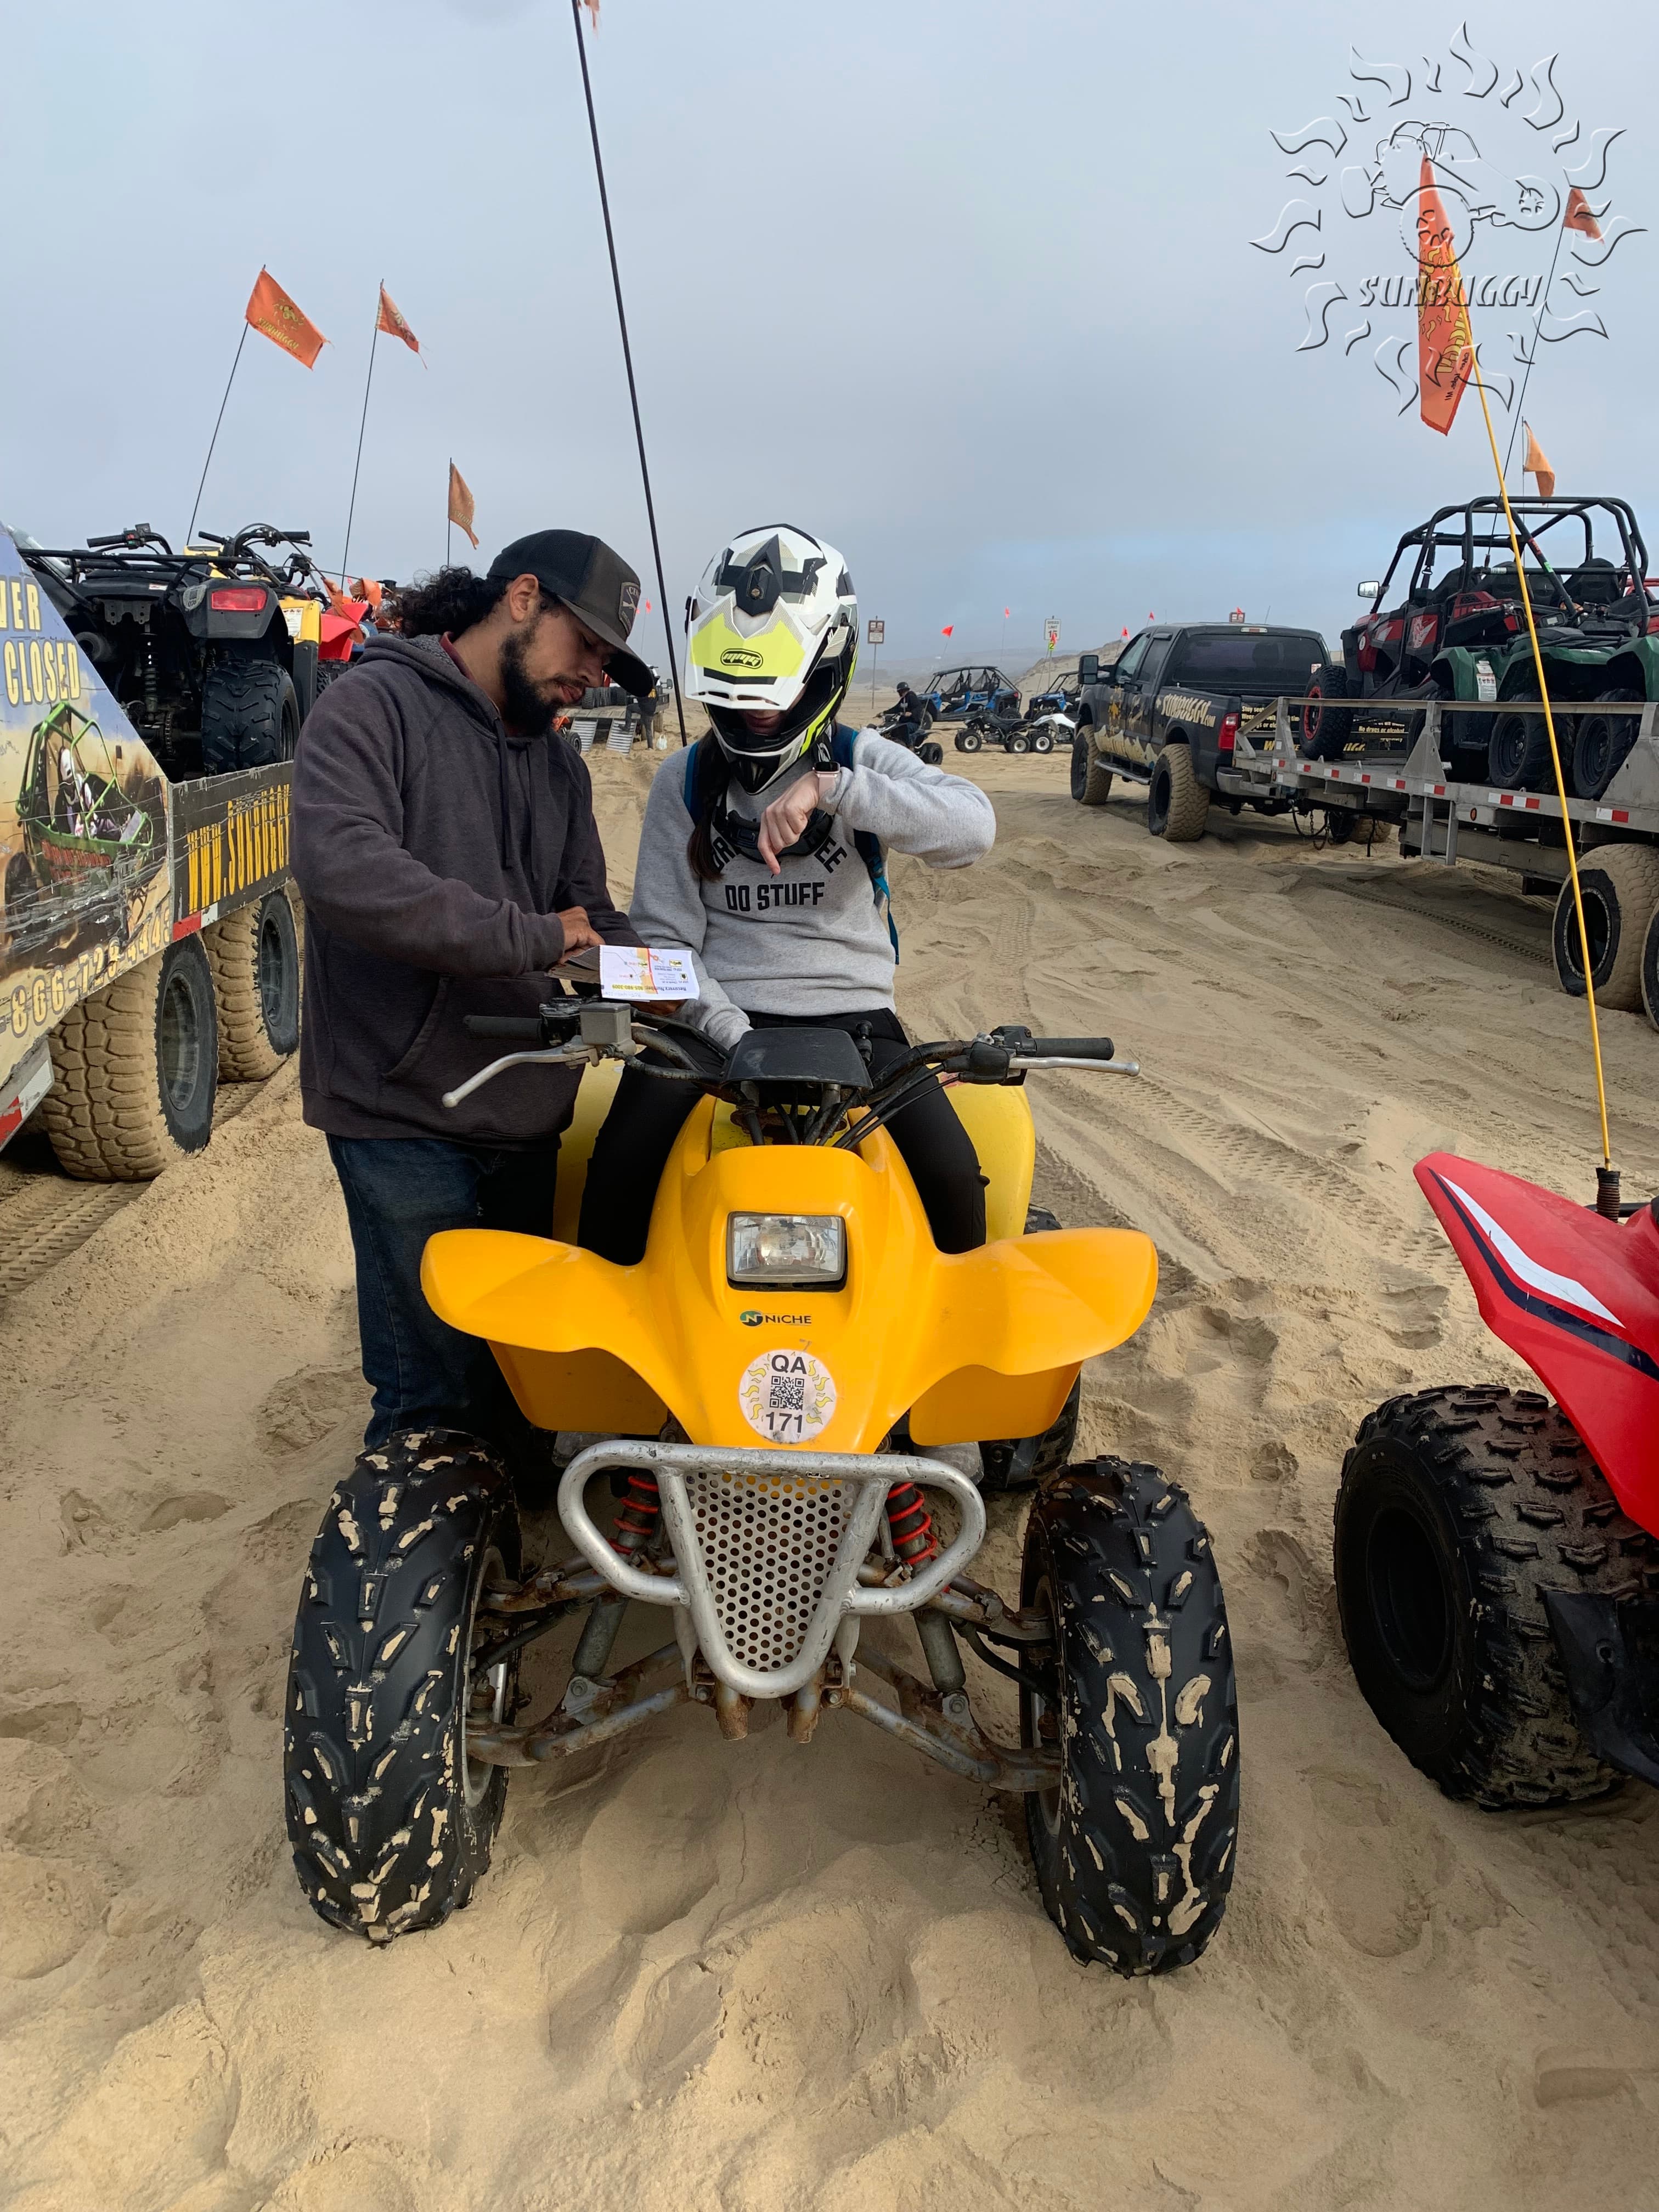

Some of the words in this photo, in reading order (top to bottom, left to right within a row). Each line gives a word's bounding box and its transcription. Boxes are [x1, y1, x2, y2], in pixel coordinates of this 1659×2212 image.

[4, 640, 81, 706] CLOSED
[725, 884, 751, 912] DO
[757, 882, 825, 911] STUFF
[771, 1355, 807, 1374] QA
[765, 1412, 803, 1434] 171
